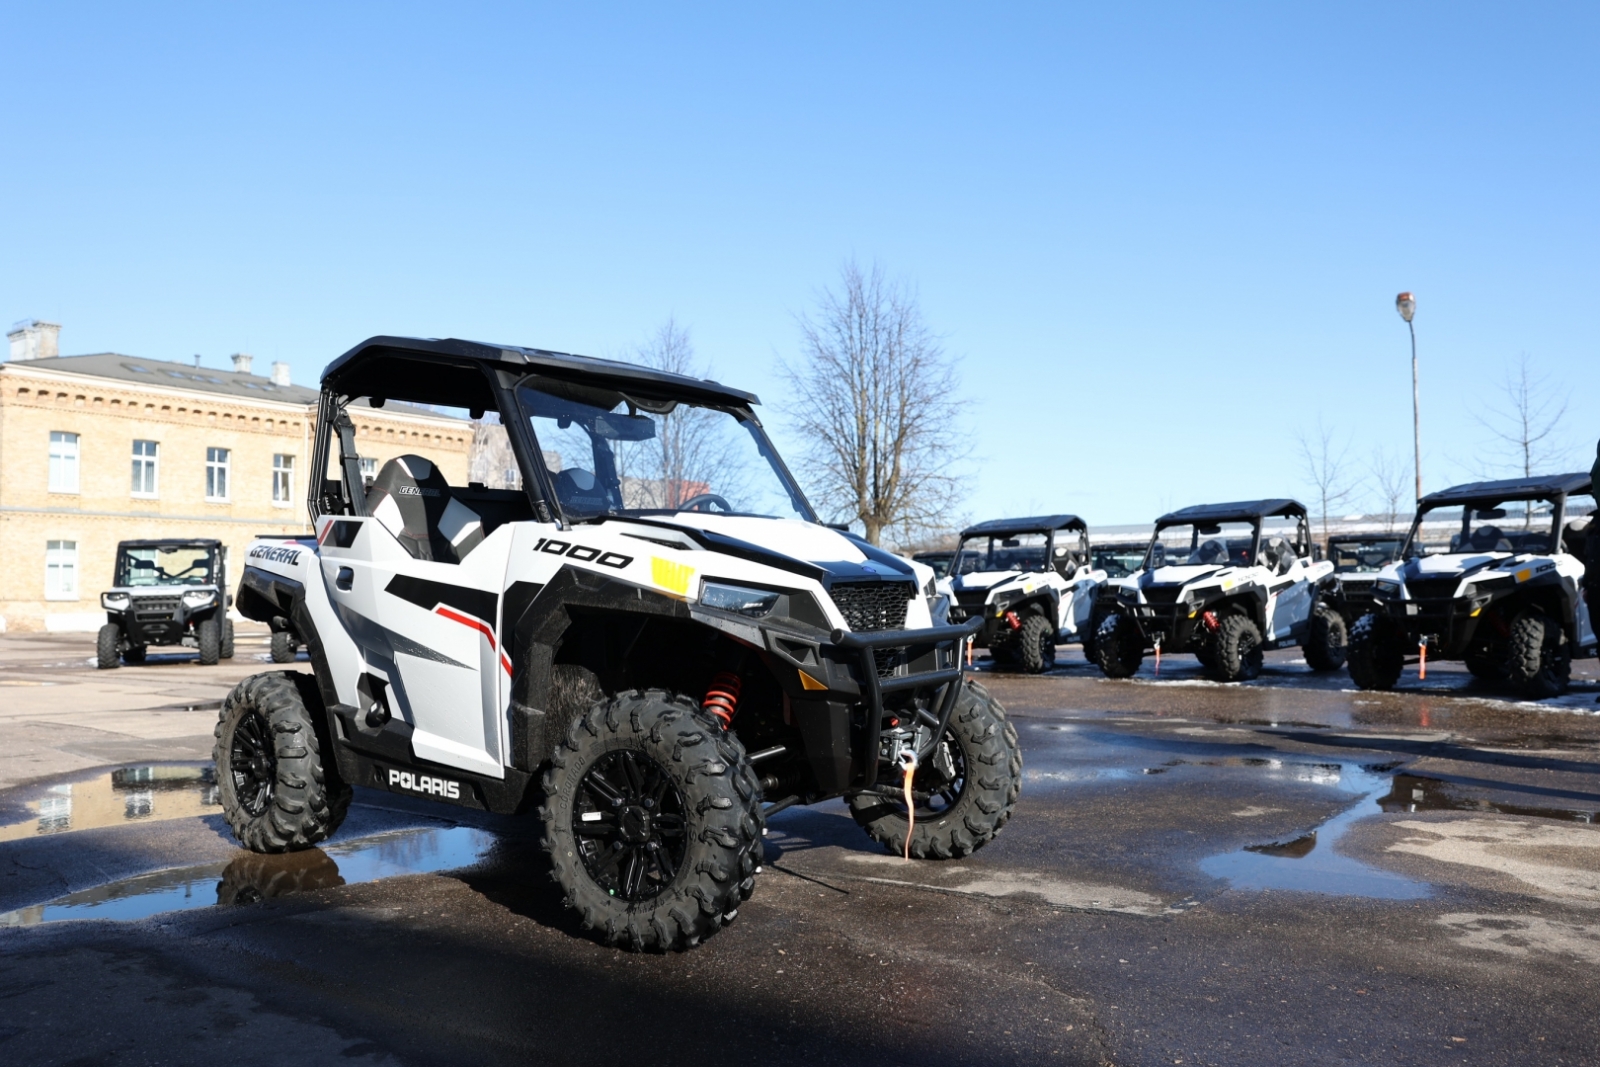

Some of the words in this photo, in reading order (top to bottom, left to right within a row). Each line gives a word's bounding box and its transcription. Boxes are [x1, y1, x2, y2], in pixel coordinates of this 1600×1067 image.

[249, 545, 302, 566] GENERAL
[532, 538, 634, 569] 1000
[388, 769, 460, 799] POLARIS
[560, 756, 586, 809] CORONADO
